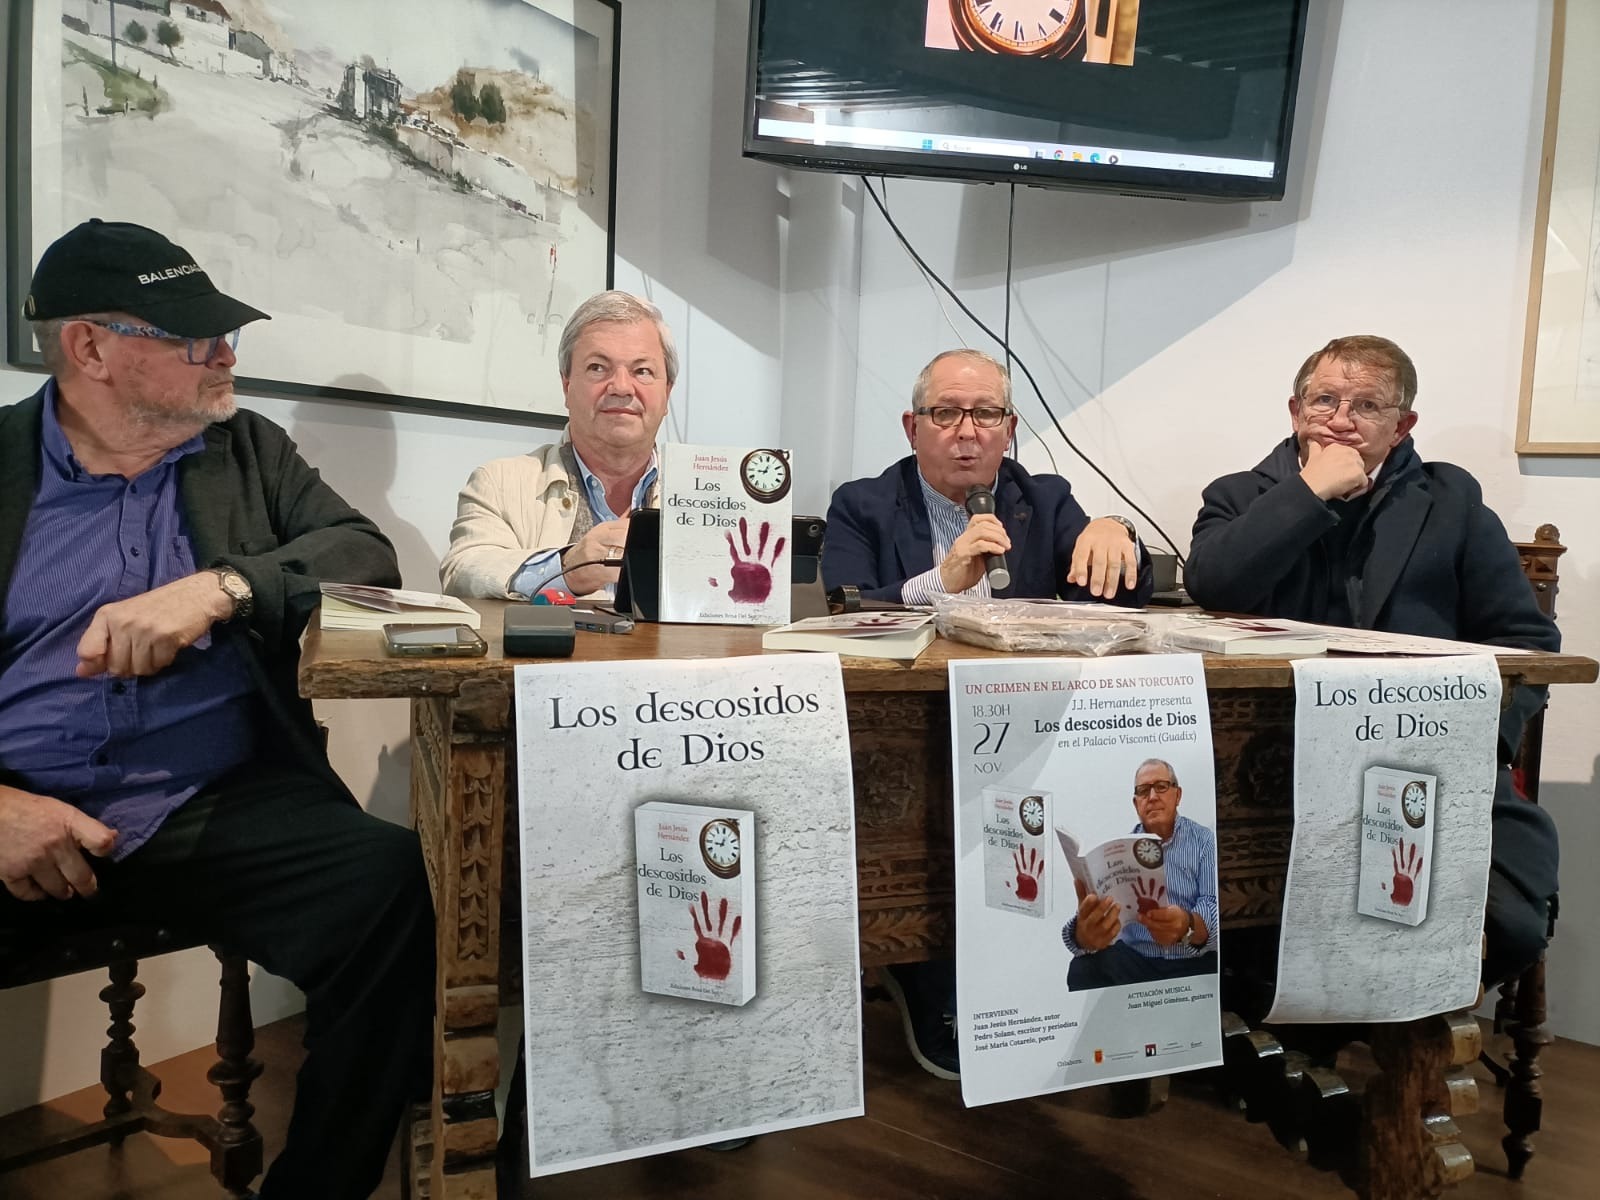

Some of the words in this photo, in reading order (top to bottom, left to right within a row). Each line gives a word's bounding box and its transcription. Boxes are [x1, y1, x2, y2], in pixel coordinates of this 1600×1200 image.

[695, 478, 721, 491] Los
[668, 494, 746, 510] descosidos
[676, 513, 695, 525] de
[702, 513, 737, 527] Dios
[966, 684, 982, 694] UN
[986, 682, 1031, 693] CRIMEN
[1034, 682, 1048, 692] EN
[1052, 681, 1065, 690] EL
[1068, 679, 1097, 690] ARCO
[1100, 679, 1113, 689] DE
[1116, 678, 1136, 688] SAN
[1138, 675, 1194, 687] TORCUATO
[1315, 681, 1357, 706] Los
[1369, 675, 1487, 704] descosidos
[549, 697, 617, 729] Los
[636, 685, 819, 723] descosidos
[973, 704, 1010, 717] 18.30H
[1089, 697, 1146, 710] Hernandez
[1149, 695, 1192, 709] presenta
[1034, 719, 1060, 733] Los
[1065, 714, 1142, 731] descosidos
[1146, 713, 1163, 727] de
[1167, 711, 1197, 726] Dios
[1356, 715, 1384, 741] de
[1396, 713, 1449, 739] Dios
[974, 722, 1010, 754] 27
[1058, 740, 1070, 748] en
[1073, 737, 1081, 747] el
[1083, 735, 1117, 747] Palacio
[1119, 733, 1157, 744] Visconti
[1159, 730, 1197, 744] (Guadix)
[618, 738, 662, 770] de
[680, 732, 765, 765] Dios
[660, 848, 683, 863] Los
[638, 864, 707, 884] descosidos
[647, 883, 662, 897] de
[669, 885, 700, 902] Dios
[1128, 988, 1163, 999] ACTUACIÓN
[1165, 985, 1192, 994] MUSICAL
[1143, 999, 1163, 1008] Miguel
[974, 1008, 1019, 1020] INTERVIENEN
[974, 1023, 989, 1031] Juan
[975, 1033, 993, 1041] Pedro
[1017, 1026, 1041, 1035] escritor
[1048, 1021, 1078, 1031] periodista
[1039, 1034, 1055, 1043] poeta
